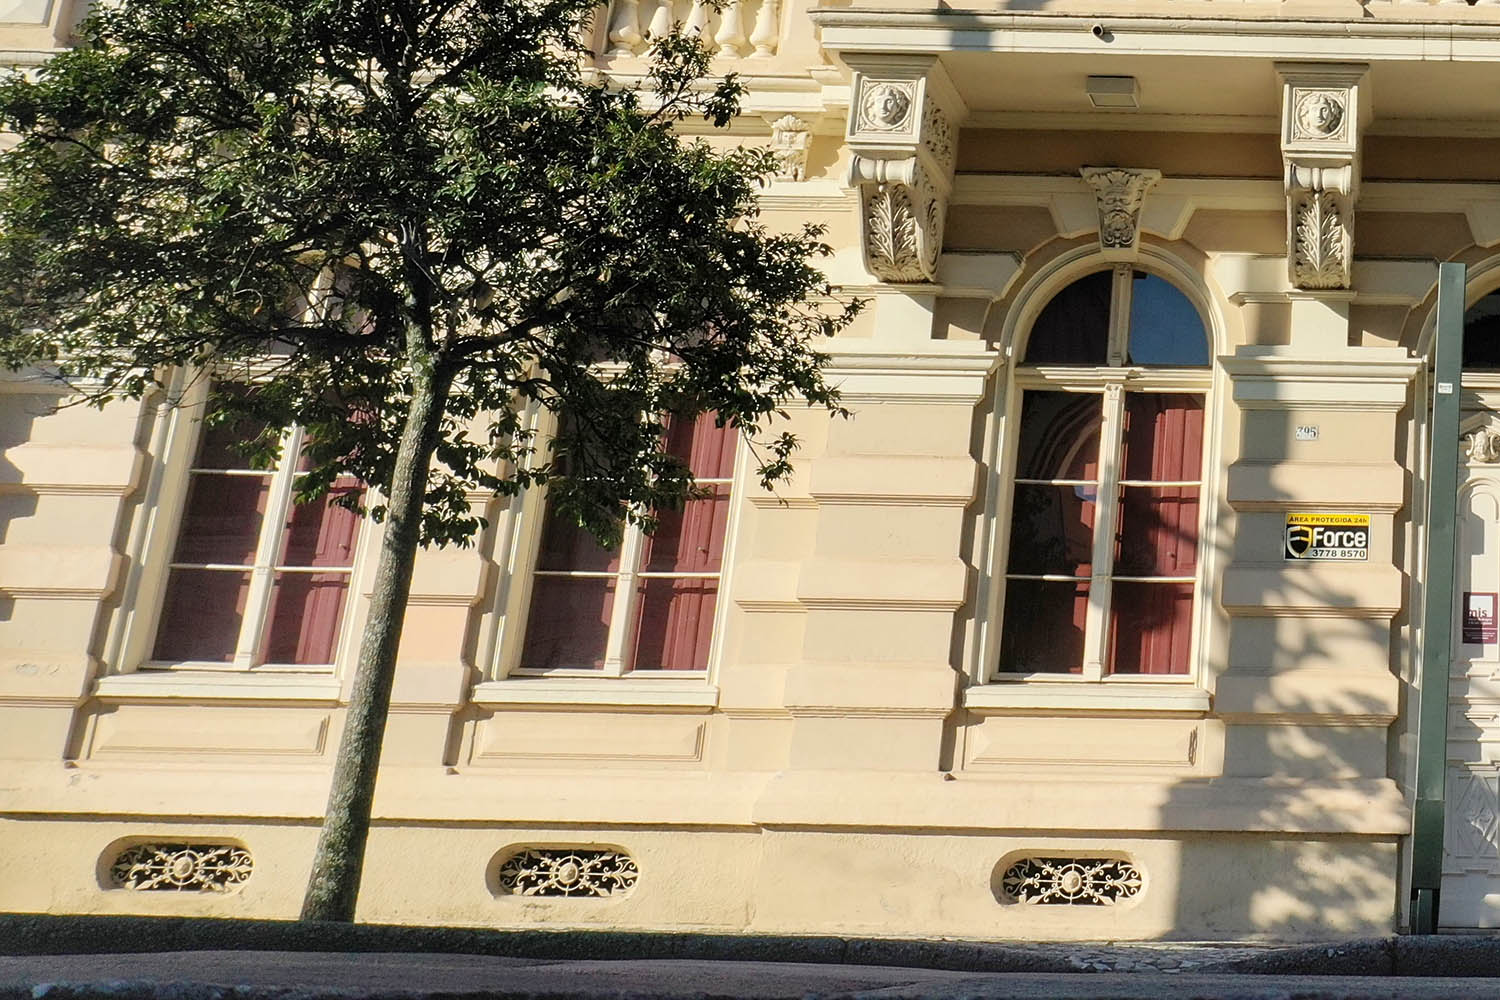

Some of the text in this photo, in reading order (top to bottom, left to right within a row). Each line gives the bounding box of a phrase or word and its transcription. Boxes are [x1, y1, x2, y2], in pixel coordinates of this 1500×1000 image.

[1311, 516, 1352, 524] PROTEGIDA
[1312, 527, 1367, 548] Force
[1312, 549, 1366, 558] 3778 8570
